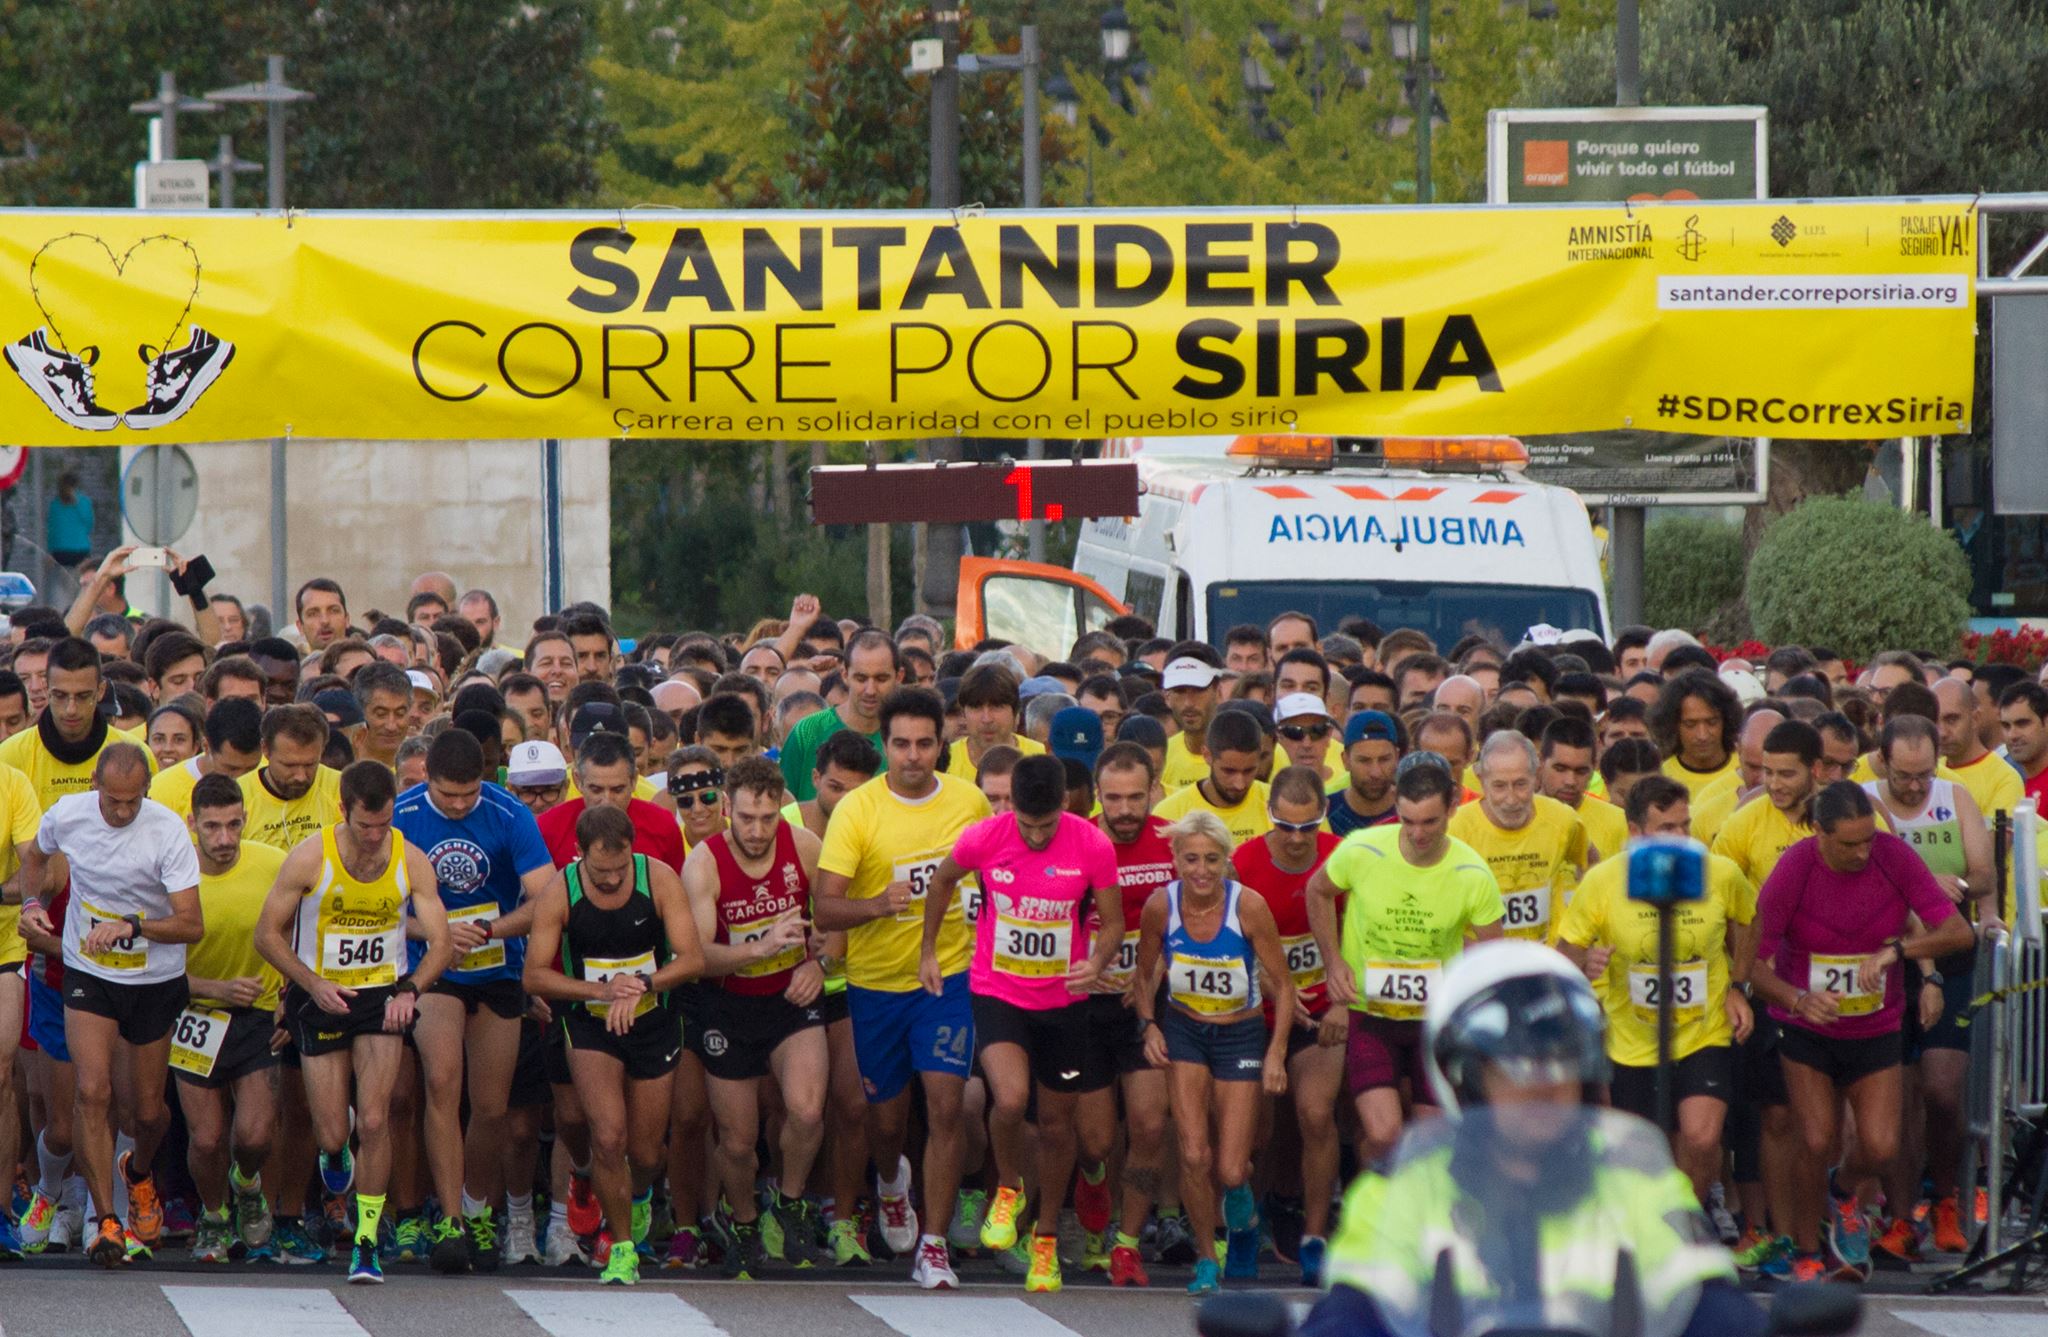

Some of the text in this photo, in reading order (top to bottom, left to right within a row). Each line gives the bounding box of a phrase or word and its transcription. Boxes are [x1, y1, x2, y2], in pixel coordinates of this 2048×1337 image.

[1577, 141, 1699, 157] Porque quiero
[1526, 172, 1566, 184] orange
[1576, 160, 1735, 176] vivir todo el fútbol
[1568, 220, 1653, 246] AMNISTÍA
[1901, 216, 1937, 235] PASAJE
[1938, 215, 1970, 257] YA!
[1568, 247, 1654, 262] INTERNACIONAL
[1901, 237, 1939, 256] SEGURO
[567, 222, 1342, 314] SANTANDER
[1670, 284, 1957, 303] santander.correporsiria.org
[413, 313, 1505, 403] CORRE POR SIRIA
[613, 405, 1298, 434] Carrera en solidaridad con el pueblo sirio
[1657, 394, 1964, 424] #SDRCorrexSiria
[1529, 456, 1568, 464] range.es
[1561, 445, 1595, 455] Orange
[1645, 454, 1672, 463] Llama
[1674, 454, 1700, 465] gratis
[1713, 454, 1734, 463] 1414
[726, 895, 797, 921] CARCOBA
[1502, 894, 1539, 924] 63
[338, 936, 384, 966] 546
[1008, 929, 1056, 957] 300
[1287, 942, 1316, 972] 65
[1185, 970, 1233, 995] 143
[1380, 974, 1429, 1002] 453
[1644, 976, 1693, 1006] 23
[175, 1015, 211, 1048] 63
[933, 1025, 967, 1058] 24
